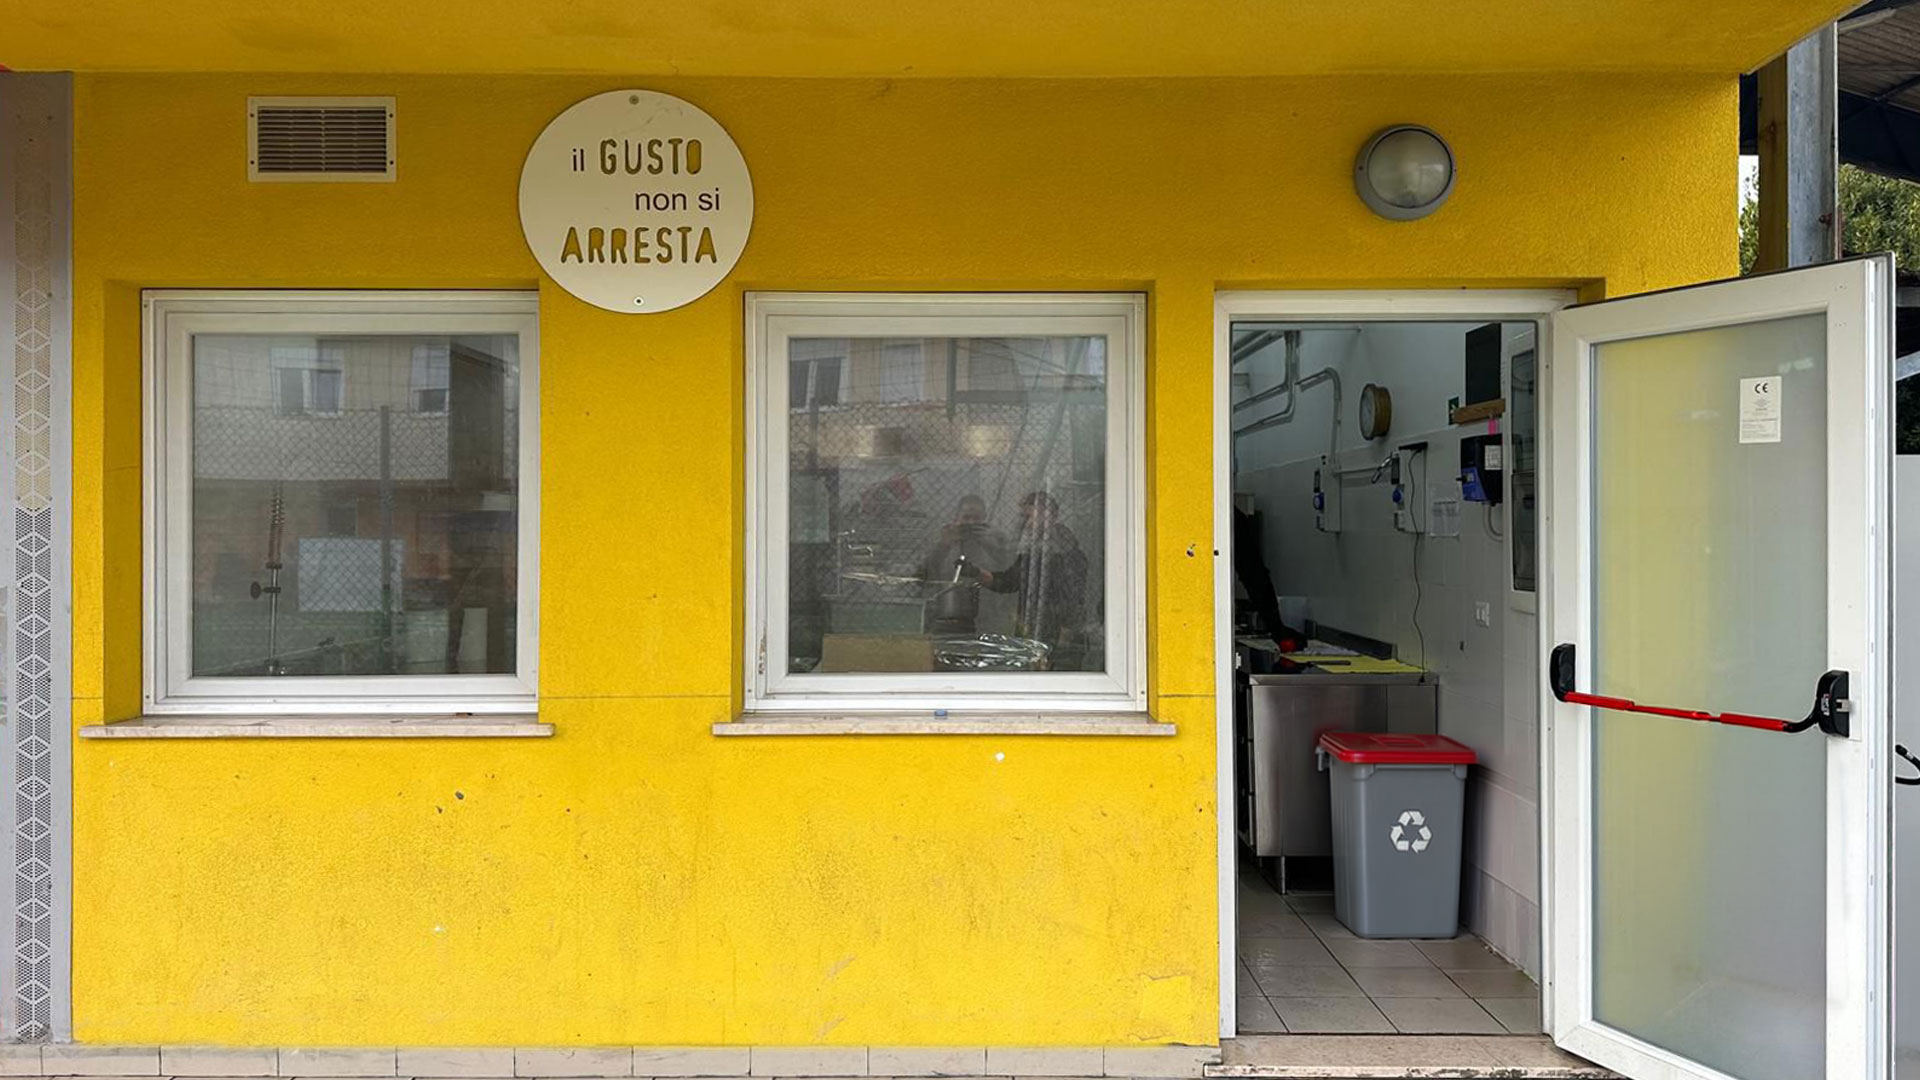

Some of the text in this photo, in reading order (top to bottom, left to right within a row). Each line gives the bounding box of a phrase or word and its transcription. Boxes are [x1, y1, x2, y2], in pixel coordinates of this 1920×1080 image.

[572, 138, 702, 175] il GUSTO
[635, 187, 720, 211] non si
[560, 226, 717, 264] ARRESTA
[1754, 382, 1769, 394] CE
